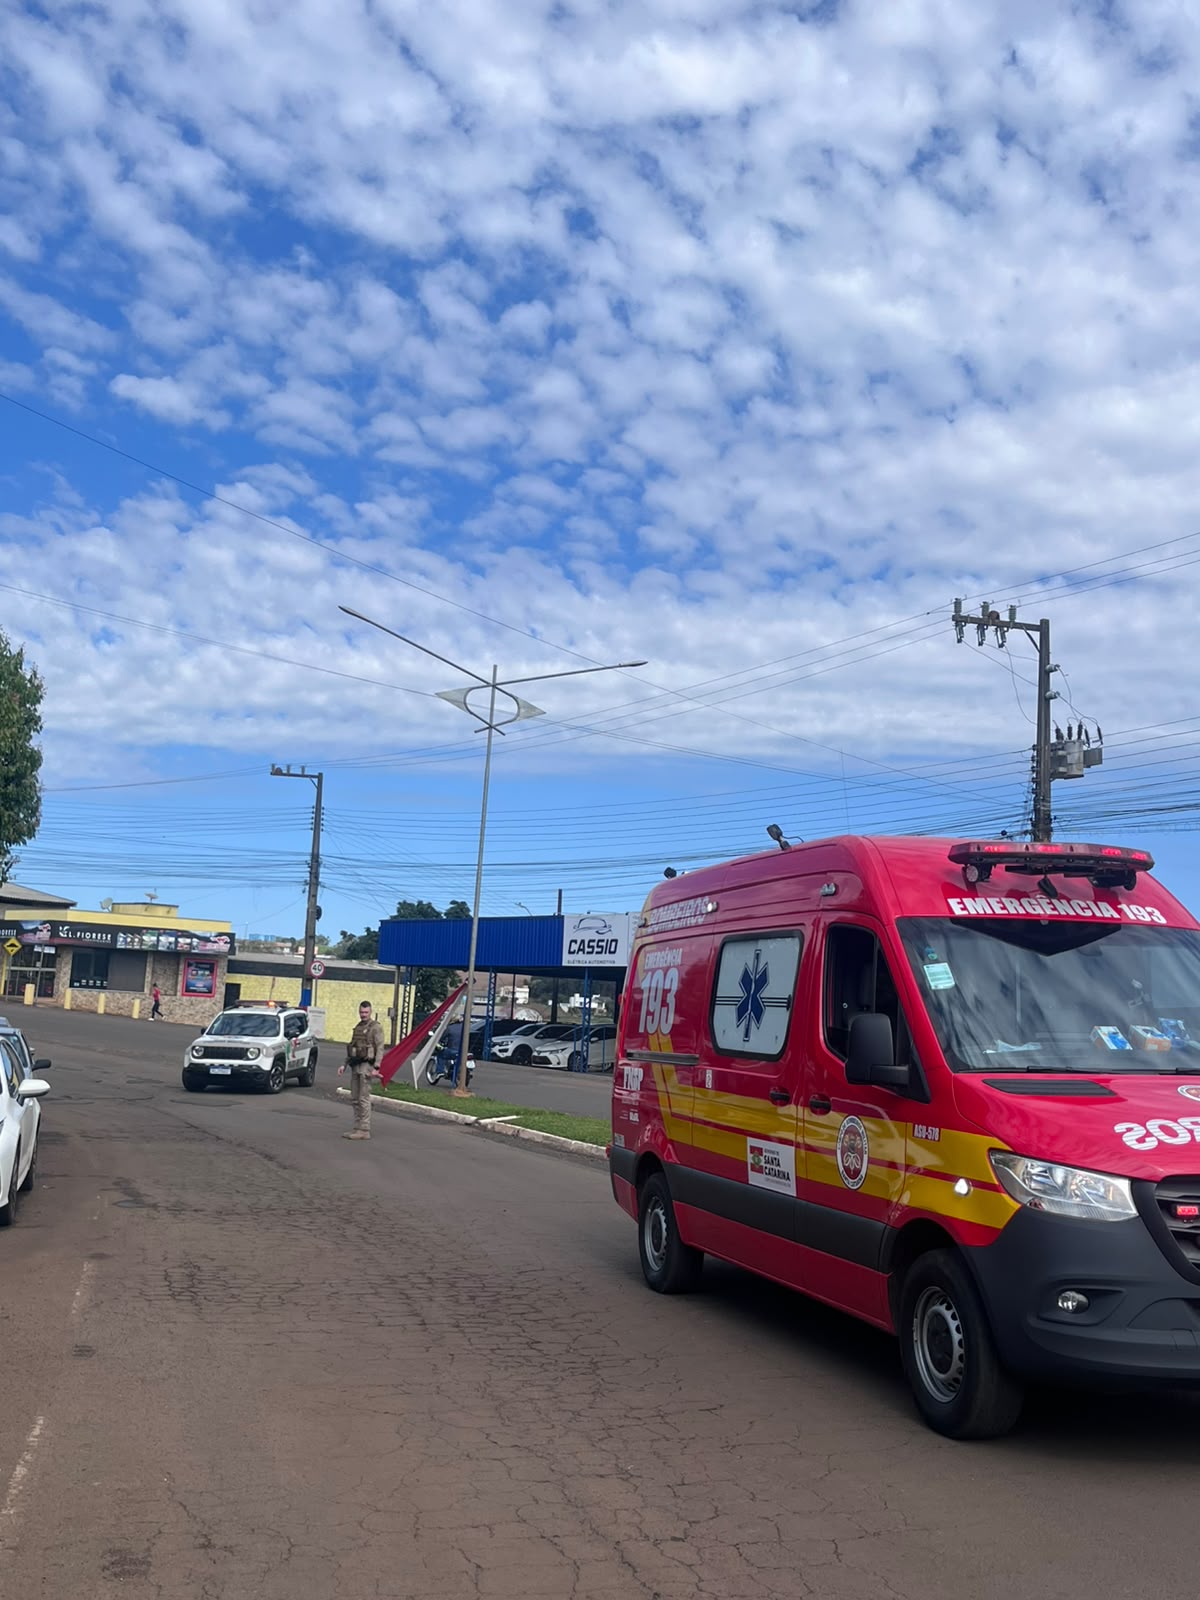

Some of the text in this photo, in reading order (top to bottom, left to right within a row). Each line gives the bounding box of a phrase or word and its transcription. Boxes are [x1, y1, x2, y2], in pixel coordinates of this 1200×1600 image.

[947, 895, 1167, 924] EMERGÊNCIA 193
[568, 939, 618, 955] CASSIO
[312, 964, 322, 972] 40
[639, 967, 678, 1034] 193
[764, 1155, 781, 1168] SANTA
[764, 1166, 791, 1182] CATARINA
